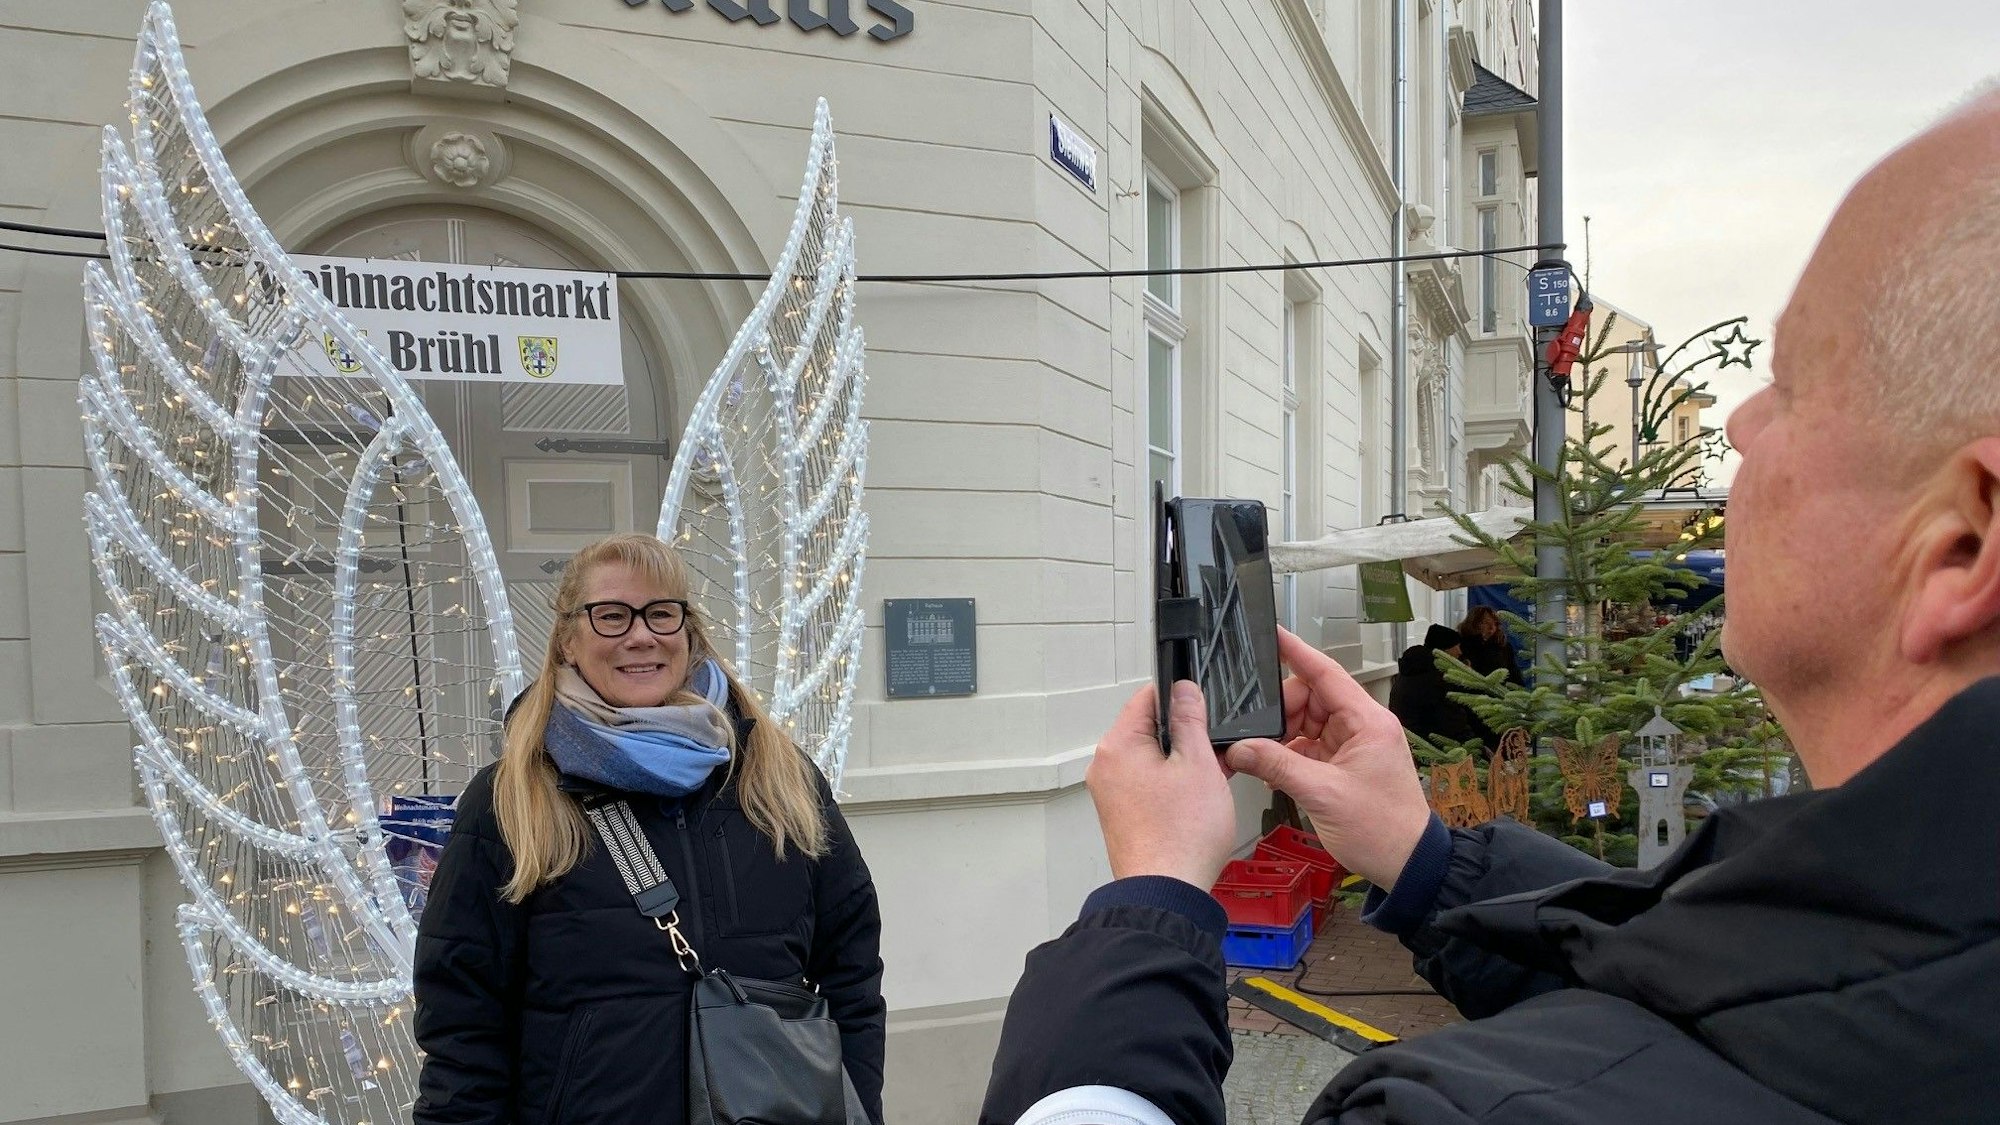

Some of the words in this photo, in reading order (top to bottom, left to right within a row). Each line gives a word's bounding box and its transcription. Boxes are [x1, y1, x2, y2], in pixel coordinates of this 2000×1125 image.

[1539, 277, 1549, 290] S
[1553, 280, 1568, 289] 150
[387, 330, 502, 374] Brühl
